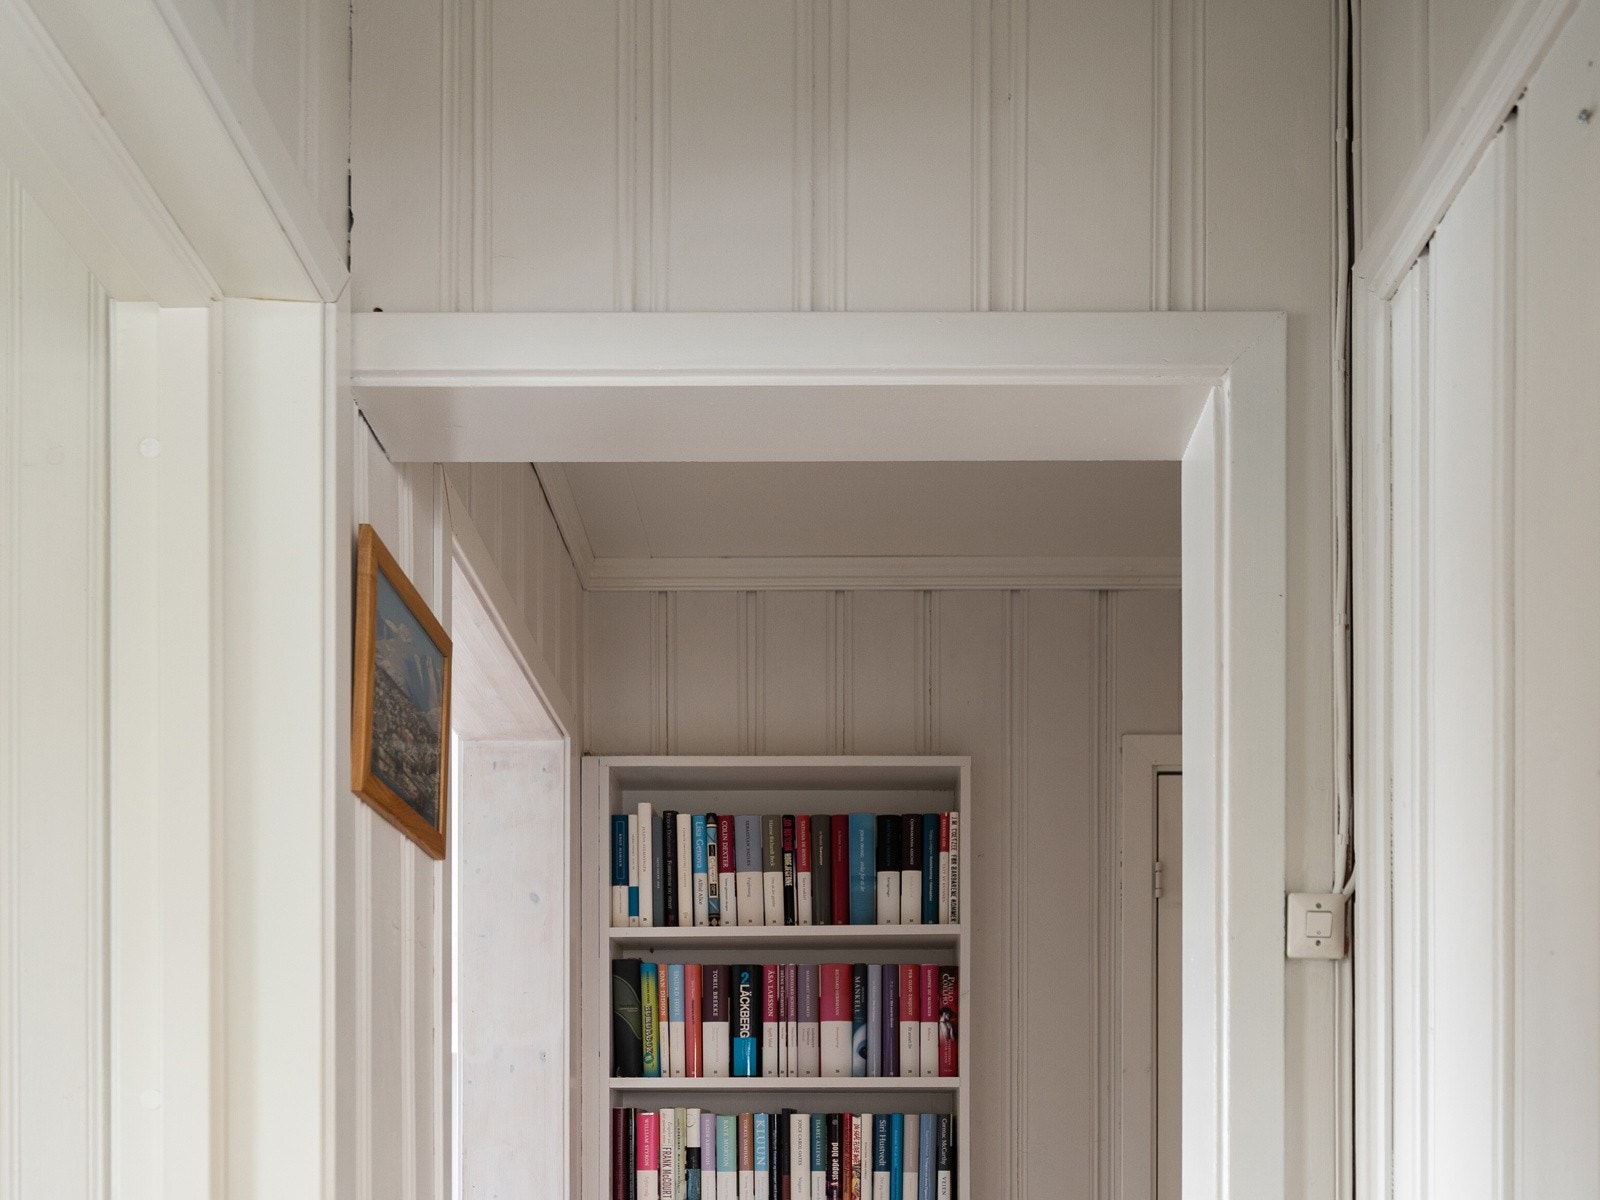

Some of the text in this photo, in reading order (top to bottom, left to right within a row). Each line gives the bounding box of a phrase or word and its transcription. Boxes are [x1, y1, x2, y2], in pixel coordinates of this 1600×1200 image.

[740, 984, 752, 1038] LÄCKBERG
[662, 1147, 672, 1167] FRANK
[756, 1120, 765, 1165] KLUUN
[831, 1143, 839, 1157] blod
[662, 1169, 672, 1198] McCOURT
